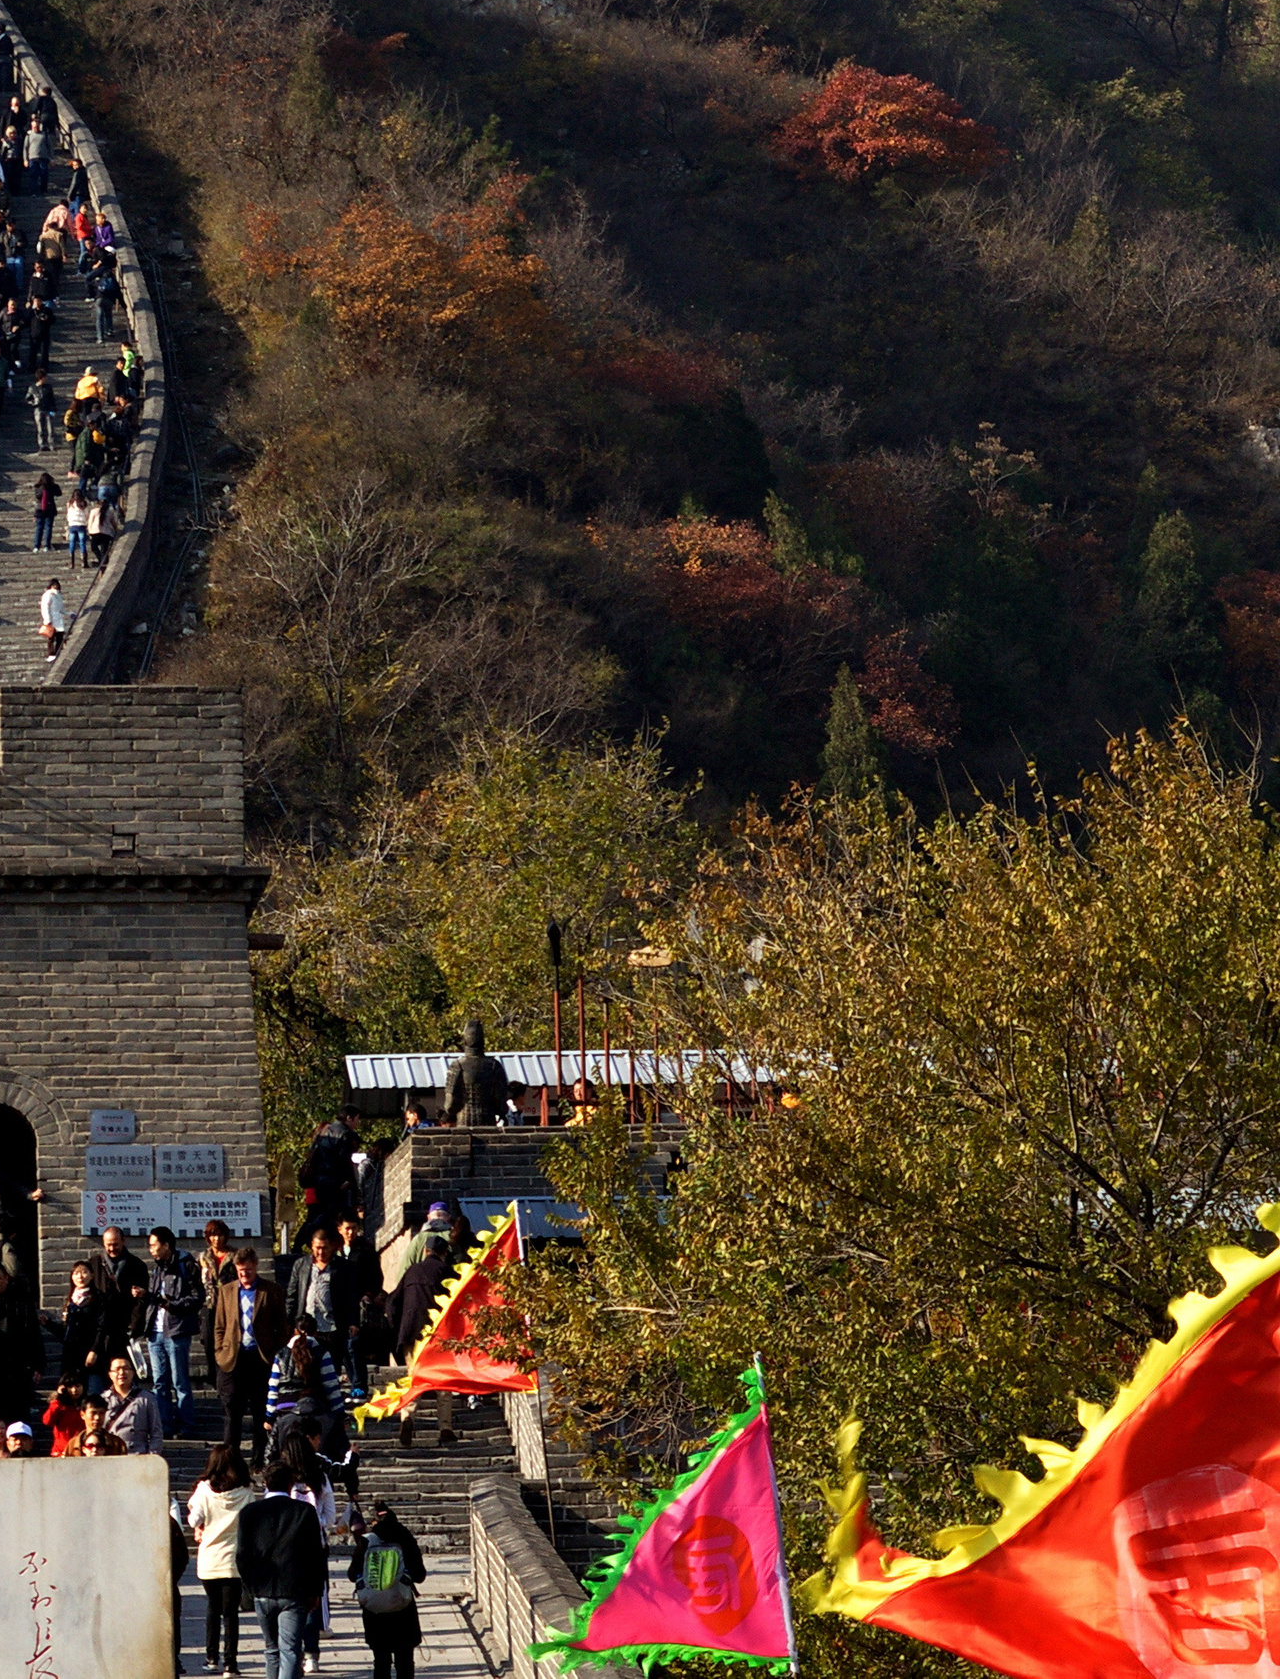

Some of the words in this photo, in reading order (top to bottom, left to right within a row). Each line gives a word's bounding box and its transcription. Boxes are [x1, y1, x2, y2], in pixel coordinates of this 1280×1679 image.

[183, 1201, 248, 1209] 如您有心脑血管病史
